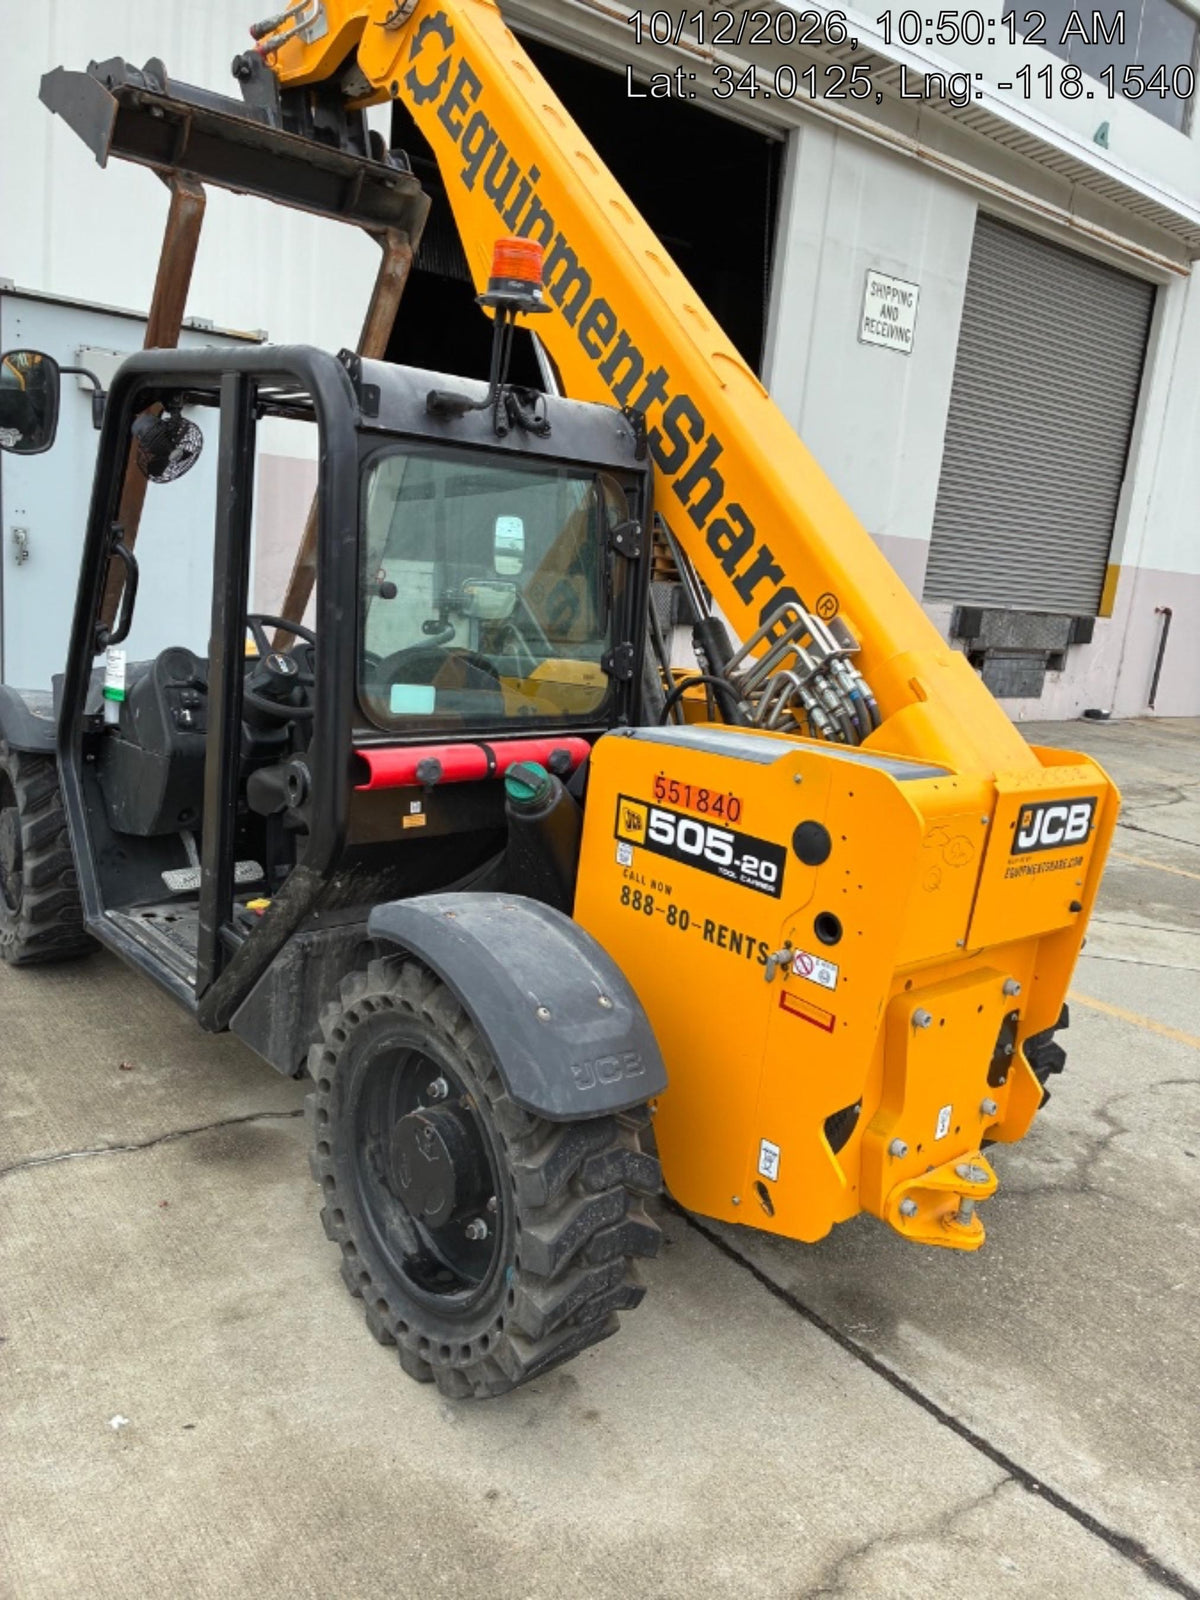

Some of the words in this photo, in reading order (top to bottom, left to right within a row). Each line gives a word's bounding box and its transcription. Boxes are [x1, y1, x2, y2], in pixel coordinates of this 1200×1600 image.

[871, 281, 913, 308] SHIPPING
[864, 316, 911, 343] RECEIVING
[880, 303, 899, 322] AND
[655, 776, 740, 822] 551840
[1018, 803, 1092, 849] JCB
[623, 868, 646, 886] CALL
[650, 880, 673, 896] NOW
[620, 885, 770, 966] 888-80-RENTS
[570, 1051, 646, 1091] JCB
